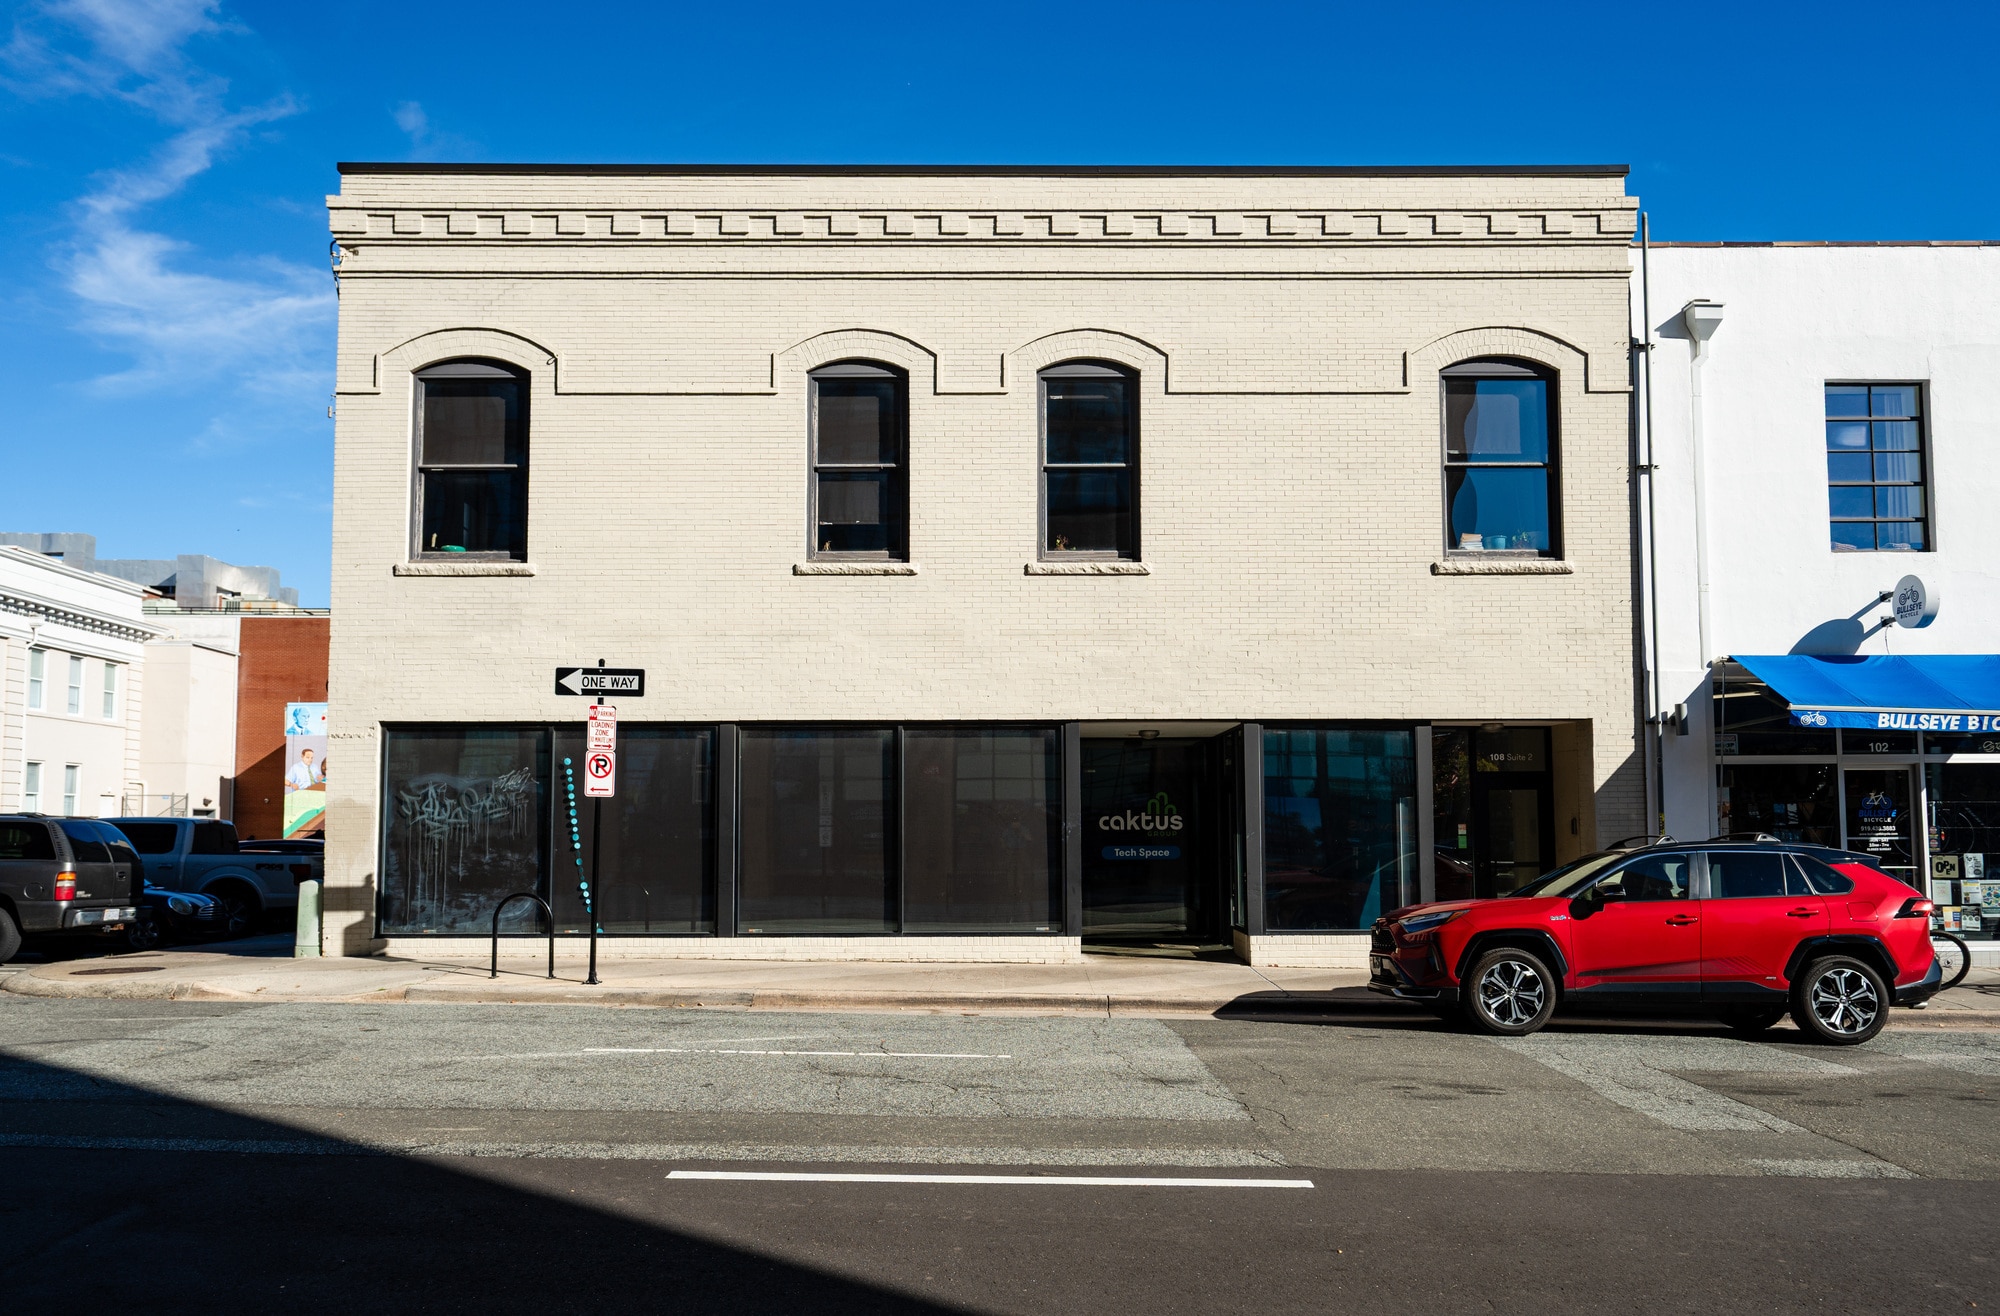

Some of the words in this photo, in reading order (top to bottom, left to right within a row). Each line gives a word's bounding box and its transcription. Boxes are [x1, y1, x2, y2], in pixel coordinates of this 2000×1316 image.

[1897, 601, 1922, 615] BULLSEYE
[1900, 611, 1919, 619] BICYCLE
[582, 676, 606, 688] ONE
[610, 677, 635, 688] WAY
[591, 721, 614, 729] LOADING
[1878, 713, 1960, 730] BULLSEYE
[1869, 742, 1889, 752] 102
[1490, 753, 1505, 761] 108
[1507, 753, 1526, 761] Suite
[1527, 753, 1533, 761] 2
[1858, 809, 1897, 817] BULLSEYE
[1099, 809, 1184, 831] caktus
[1114, 848, 1137, 857] Tech
[1139, 848, 1170, 859] Space
[1935, 860, 1956, 875] OPEN
